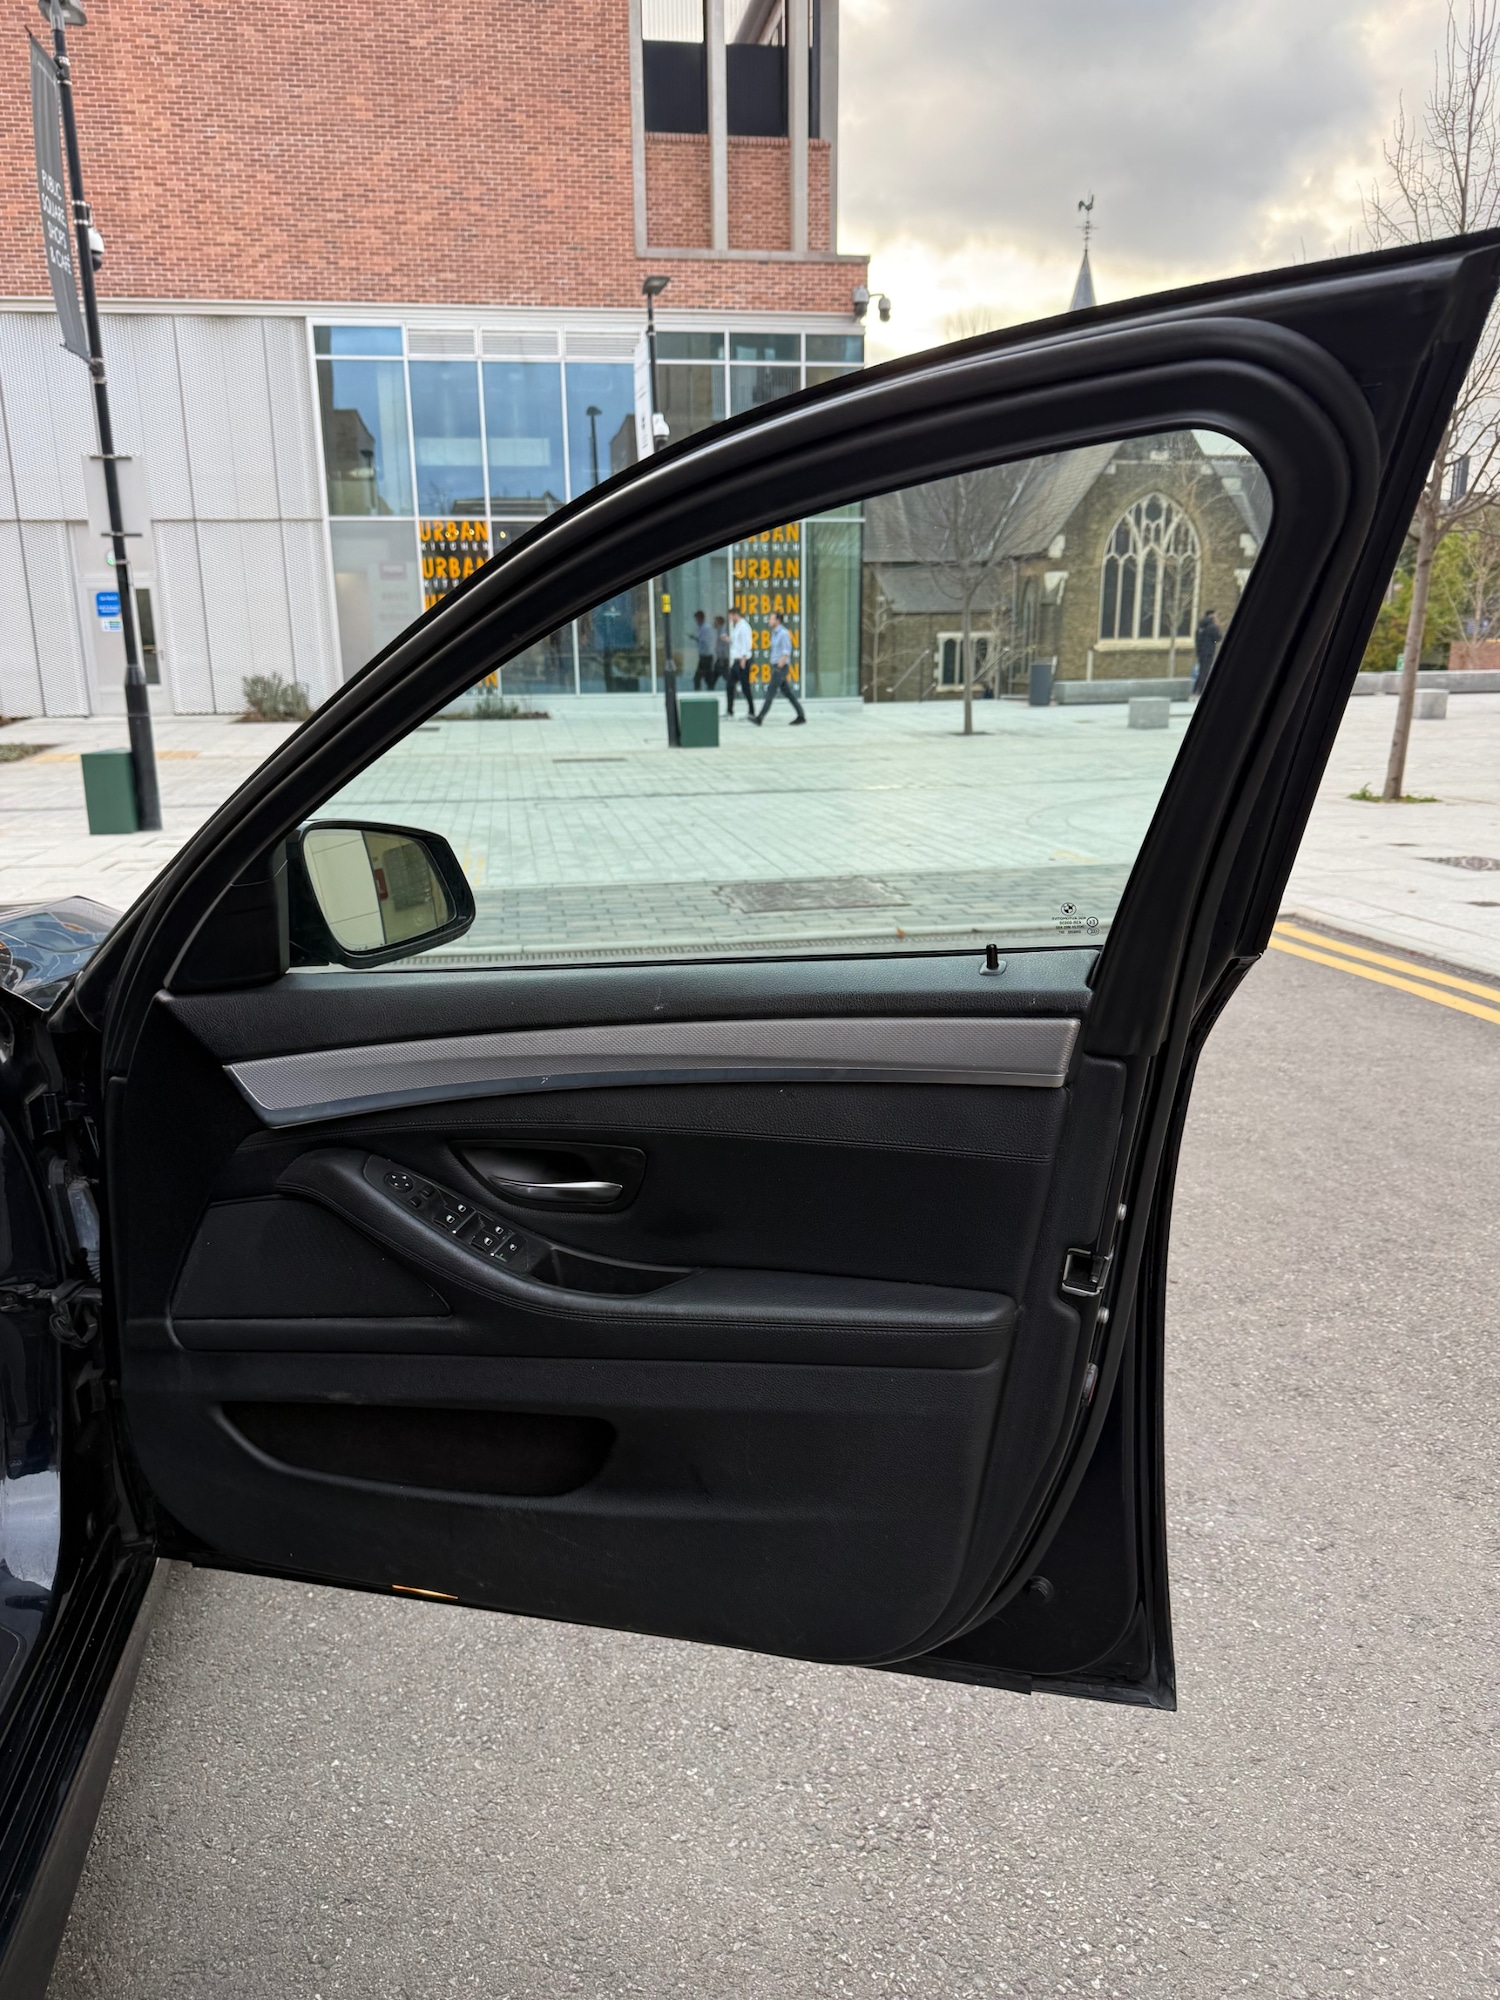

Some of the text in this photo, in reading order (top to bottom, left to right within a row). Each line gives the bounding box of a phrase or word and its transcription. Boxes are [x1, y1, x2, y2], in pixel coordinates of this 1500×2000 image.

[41, 169, 62, 200] PUBLIC
[41, 192, 67, 228] SQUARE
[47, 220, 67, 250] SHOPS
[419, 520, 489, 541] URBAN
[739, 523, 799, 542] BAN
[421, 541, 488, 551] KITCHEN
[735, 558, 799, 579] URBAN
[735, 593, 799, 614] URBAN
[751, 629, 799, 650] RBN
[749, 663, 799, 683] RBN
